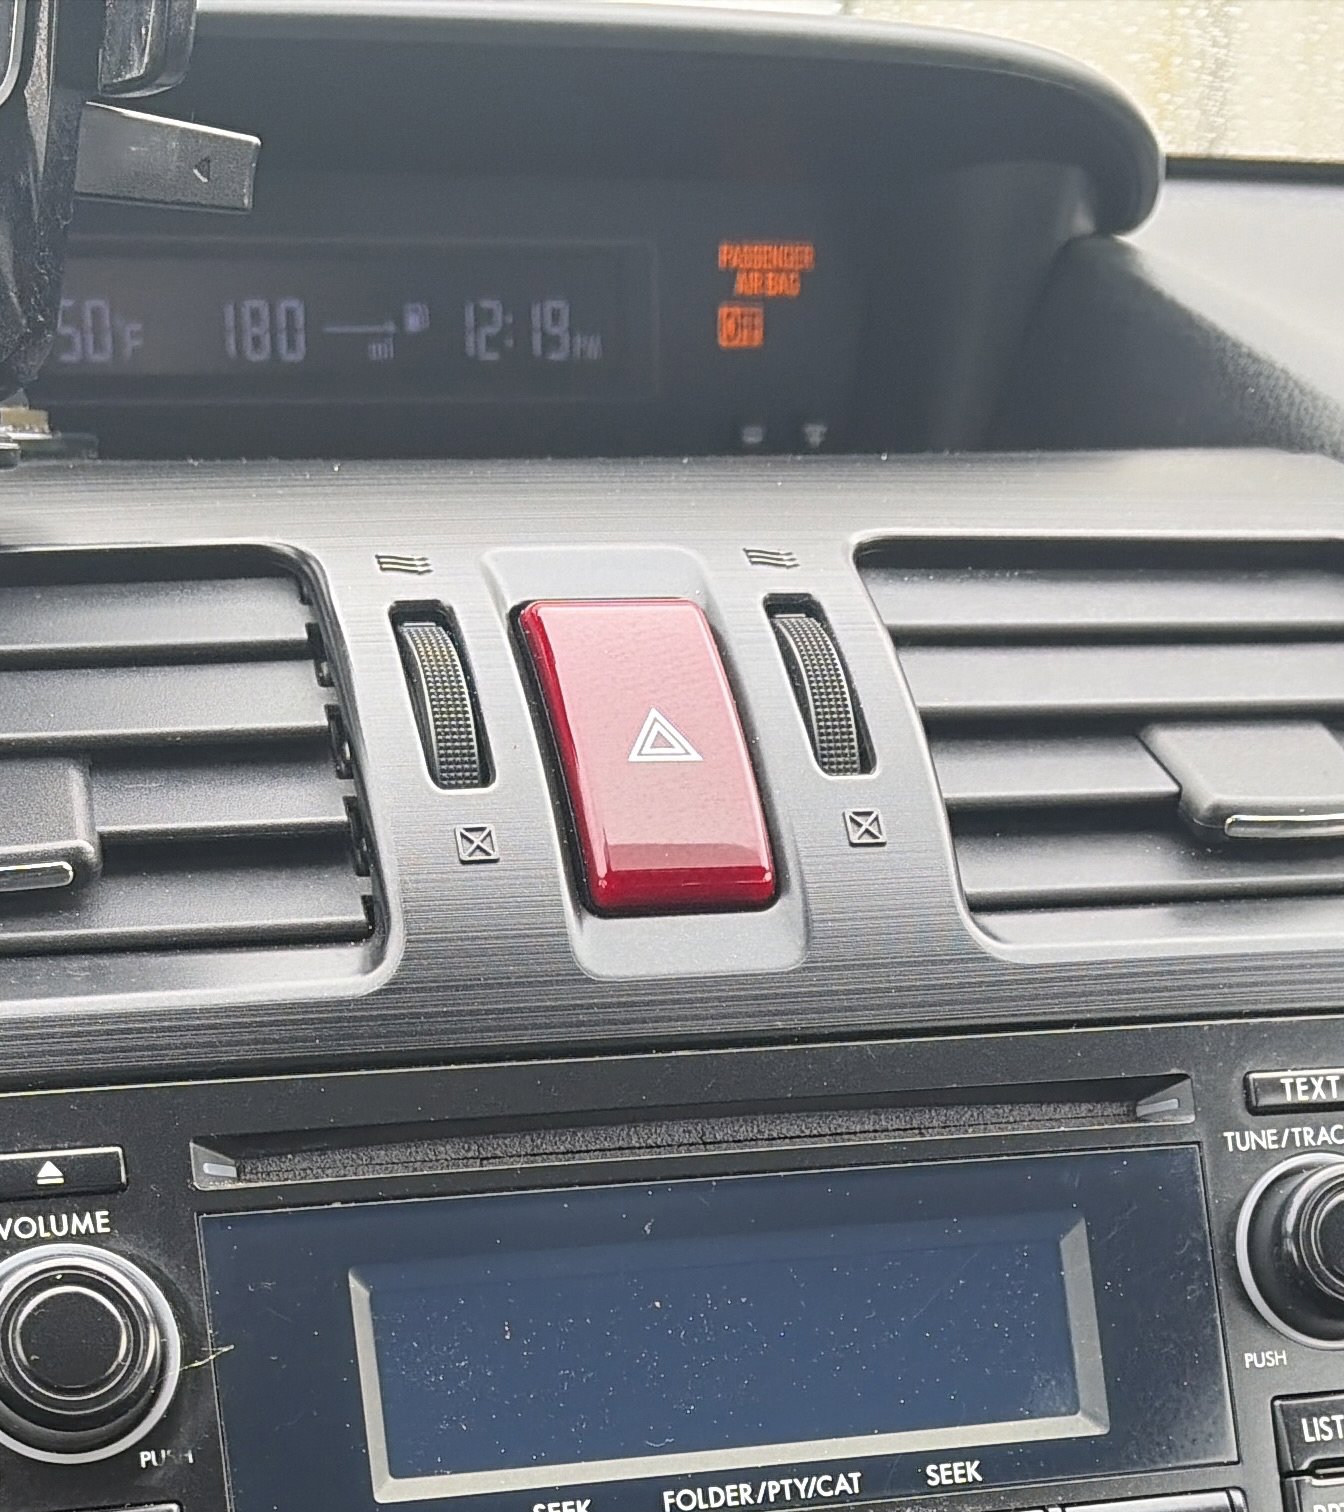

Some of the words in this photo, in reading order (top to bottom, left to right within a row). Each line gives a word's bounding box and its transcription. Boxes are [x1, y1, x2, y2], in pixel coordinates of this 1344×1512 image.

[222, 298, 306, 363] 180
[463, 298, 570, 362] 12:19
[1279, 1075, 1341, 1102] TEXT
[1244, 1349, 1288, 1369] PUSH
[925, 1460, 983, 1487] SEEK
[662, 1471, 862, 1512] FOLDER/PTY/CAT
